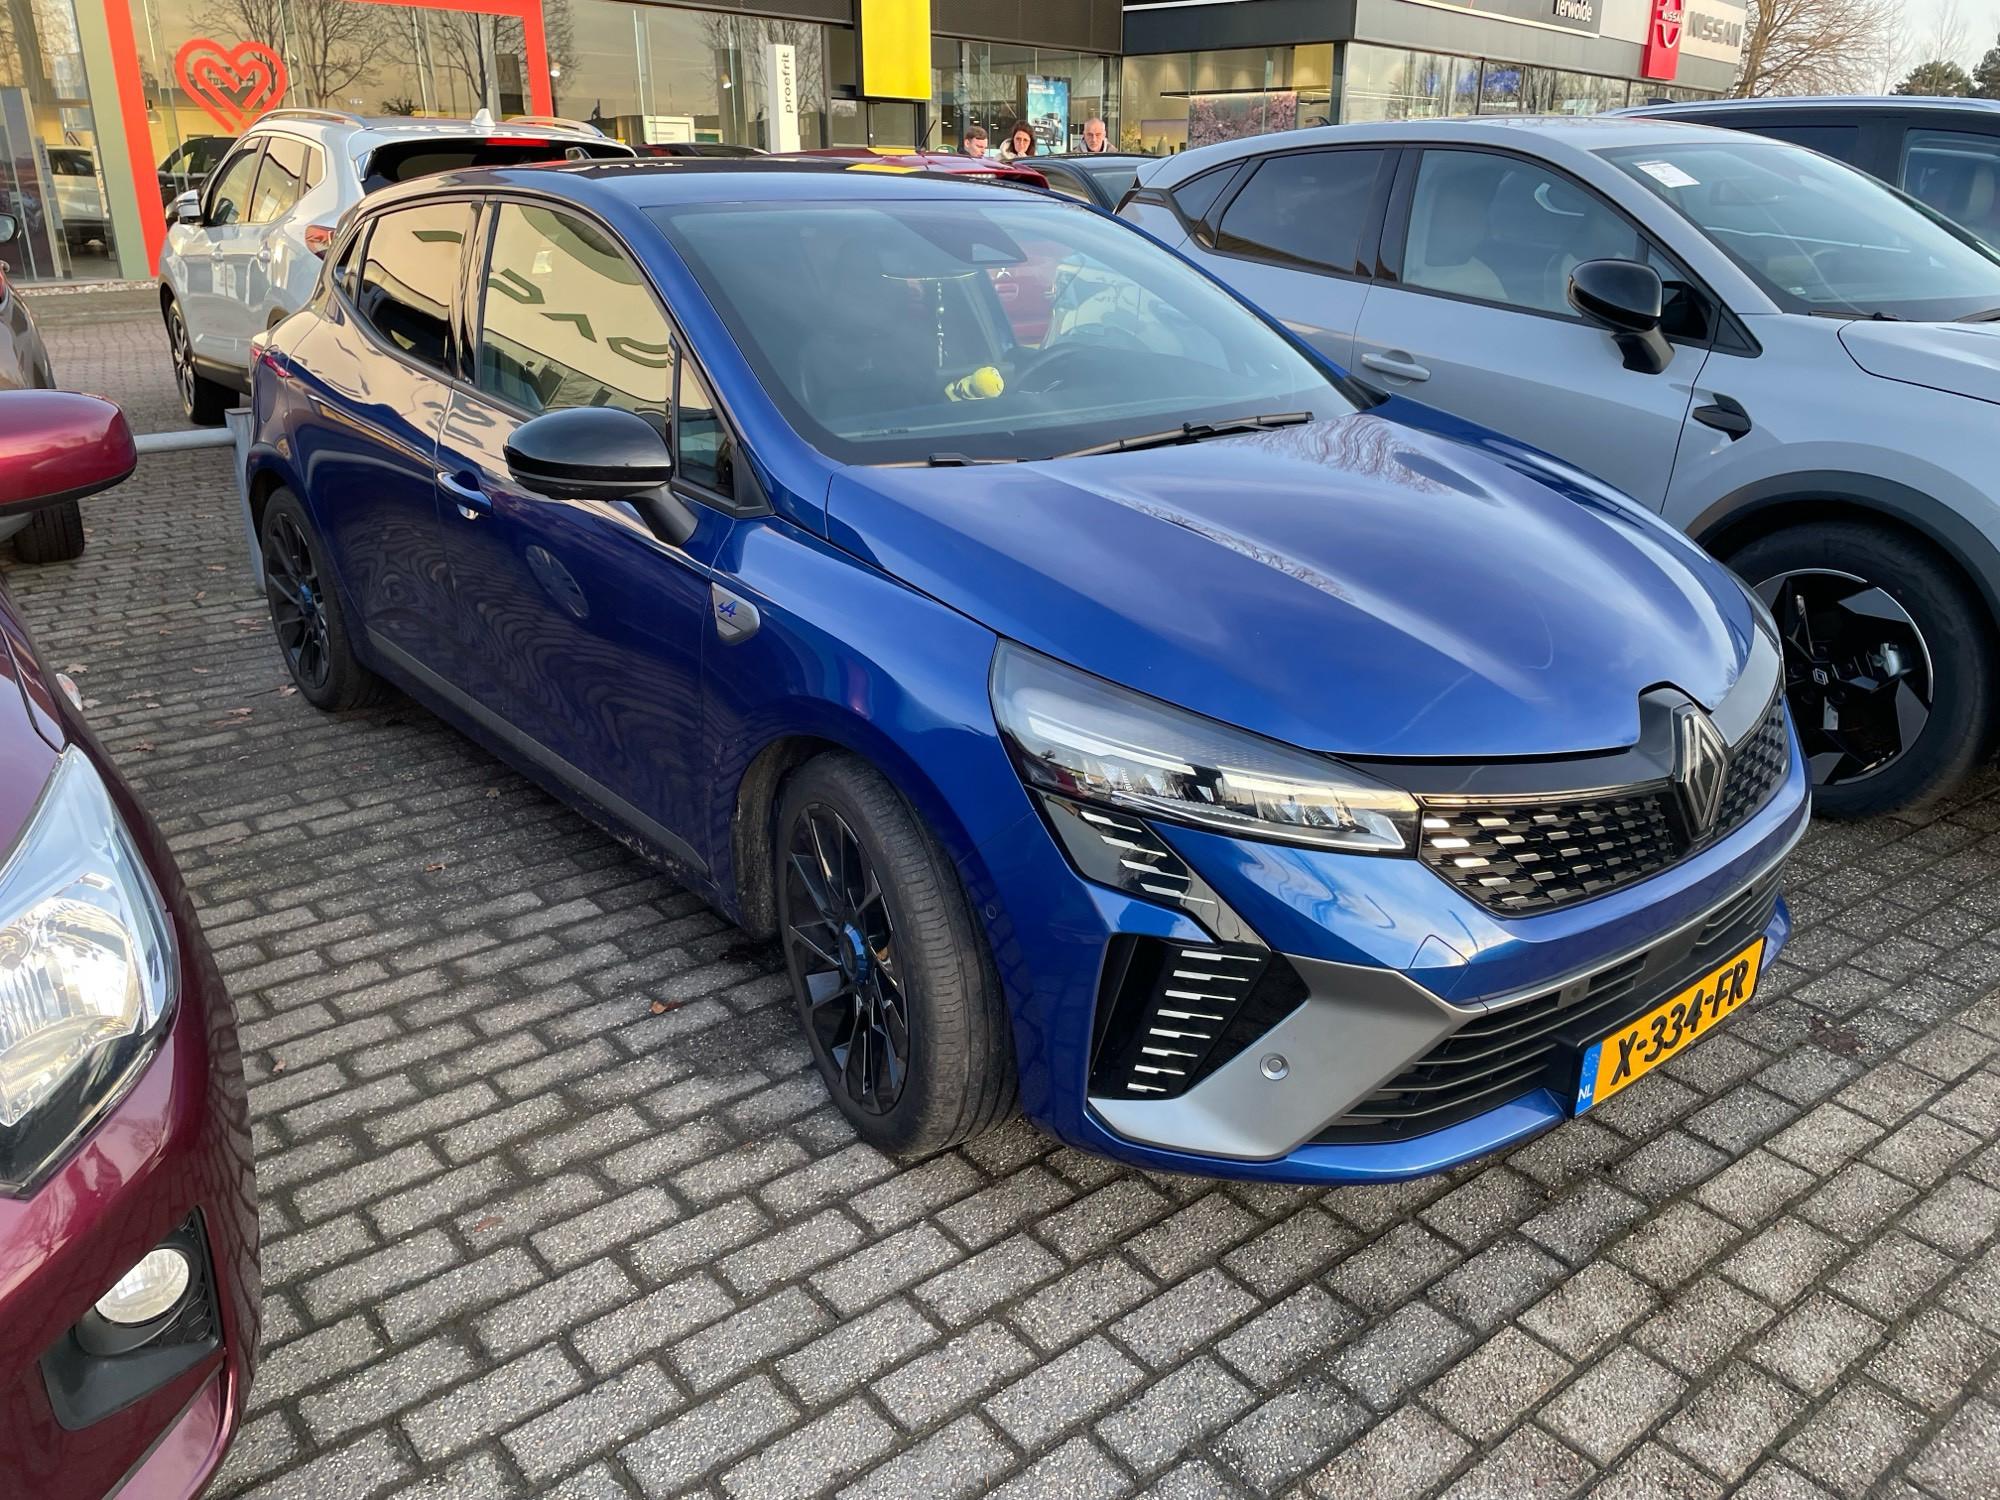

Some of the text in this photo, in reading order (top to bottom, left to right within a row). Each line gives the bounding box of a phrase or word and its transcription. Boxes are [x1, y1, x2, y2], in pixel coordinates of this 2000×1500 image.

[1556, 0, 1592, 22] Terwolde
[1687, 11, 1742, 47] NISSAN
[781, 52, 794, 113] proefrit
[1610, 959, 1749, 1085] X-334-FR
[1577, 1084, 1593, 1102] NL
